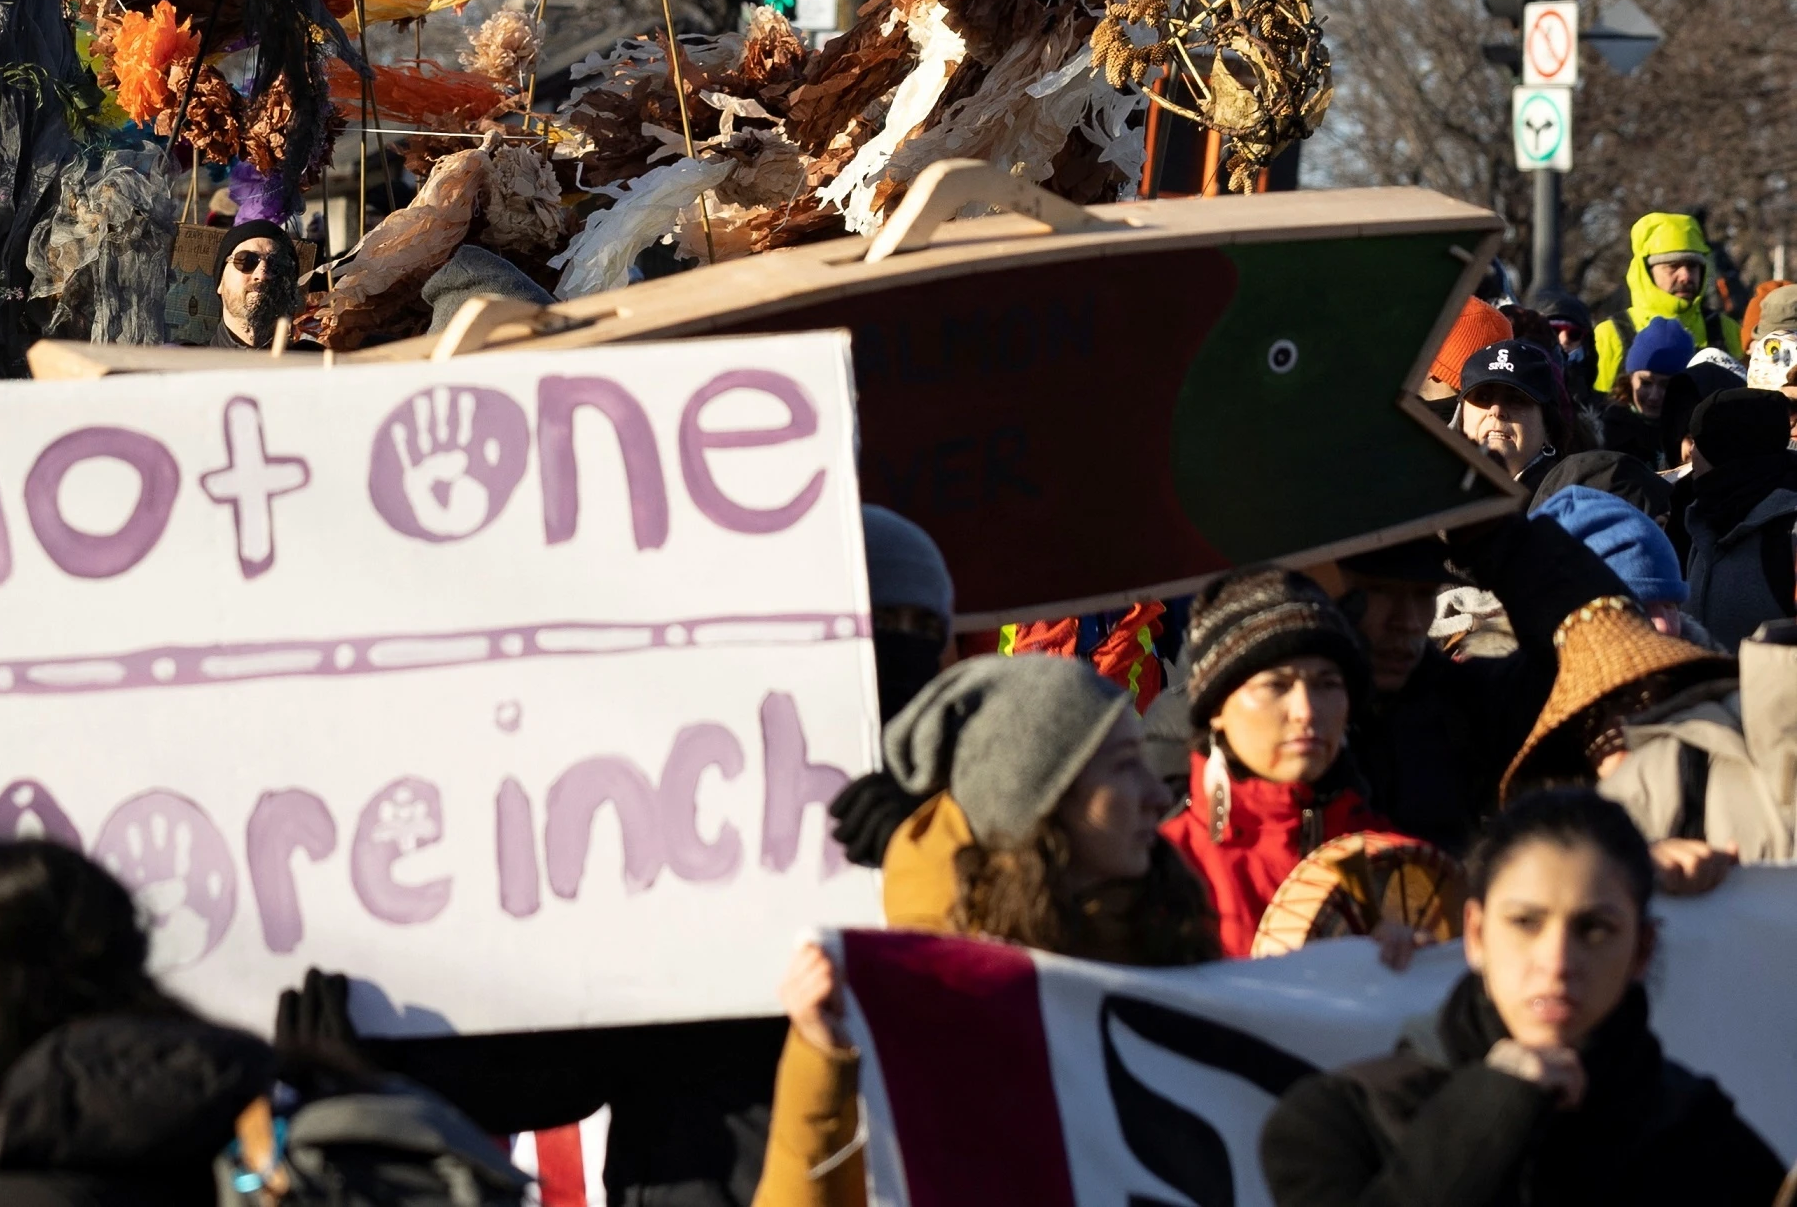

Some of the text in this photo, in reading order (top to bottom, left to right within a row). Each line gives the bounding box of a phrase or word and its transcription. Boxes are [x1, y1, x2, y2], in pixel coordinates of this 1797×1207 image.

[854, 291, 1097, 391] ALMON
[367, 366, 828, 553] one
[494, 690, 855, 919] inch
